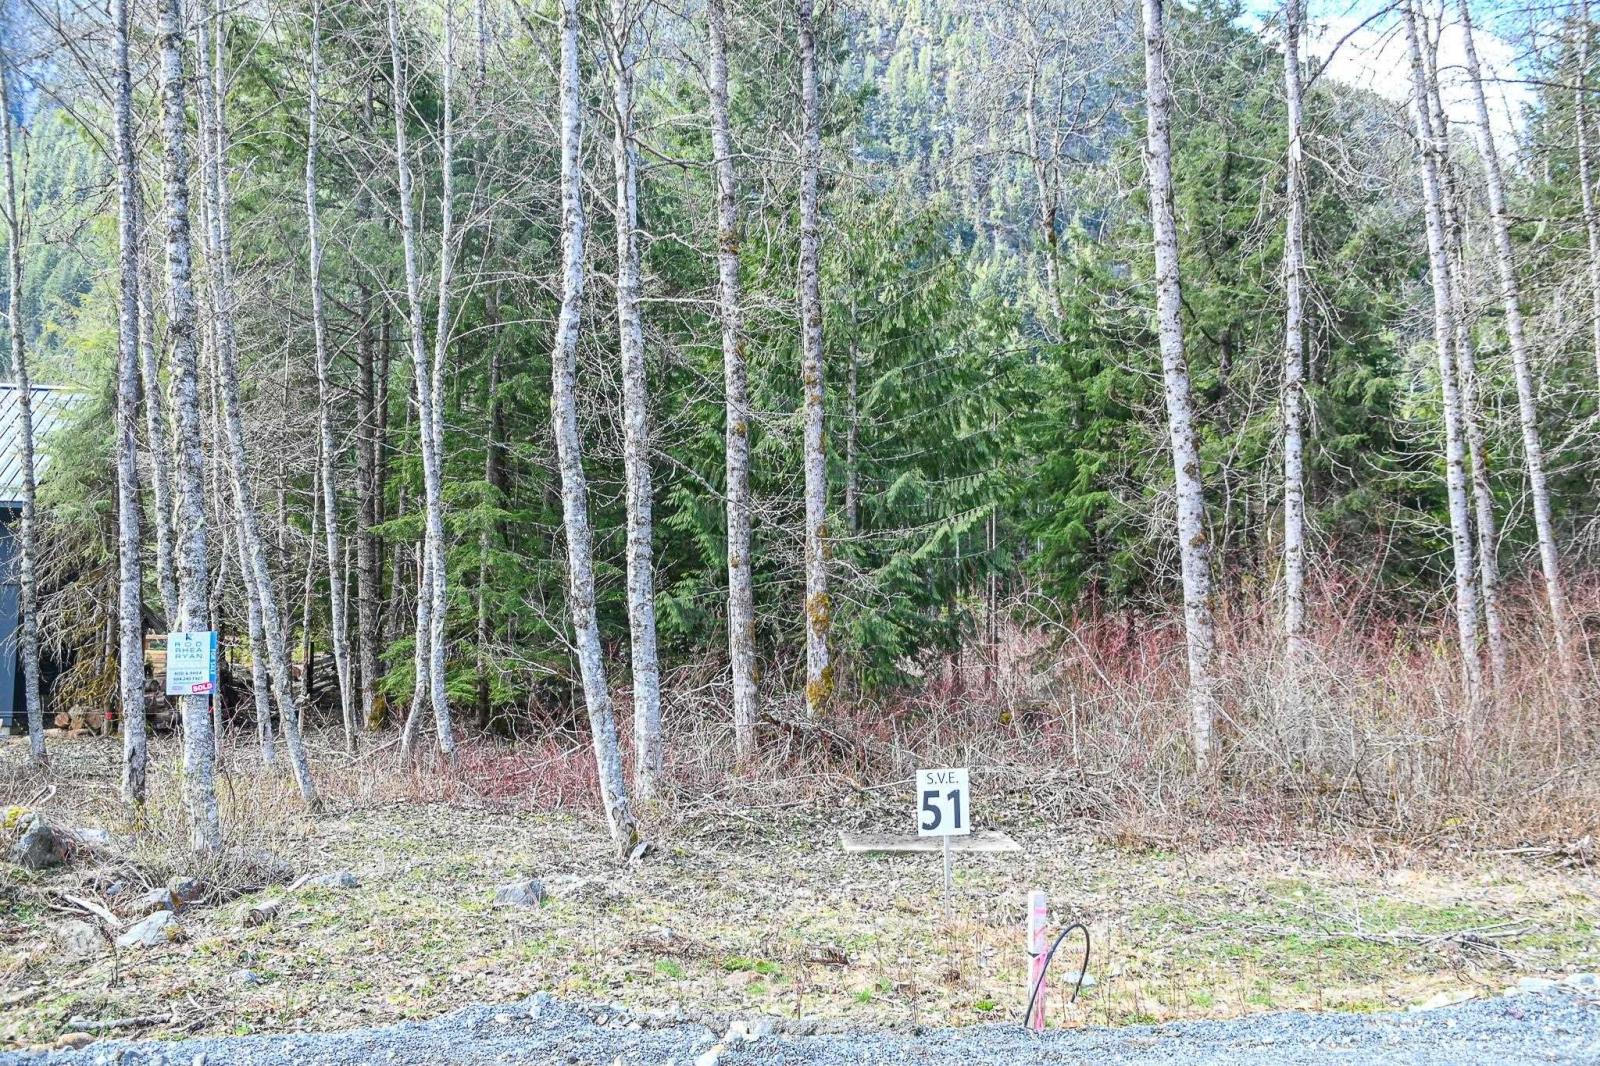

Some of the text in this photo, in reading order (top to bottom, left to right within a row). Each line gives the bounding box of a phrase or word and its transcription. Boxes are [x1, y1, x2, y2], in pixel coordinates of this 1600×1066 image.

[192, 682, 213, 692] SOLD
[926, 771, 959, 784] S.V.E.
[921, 789, 961, 831] 51
